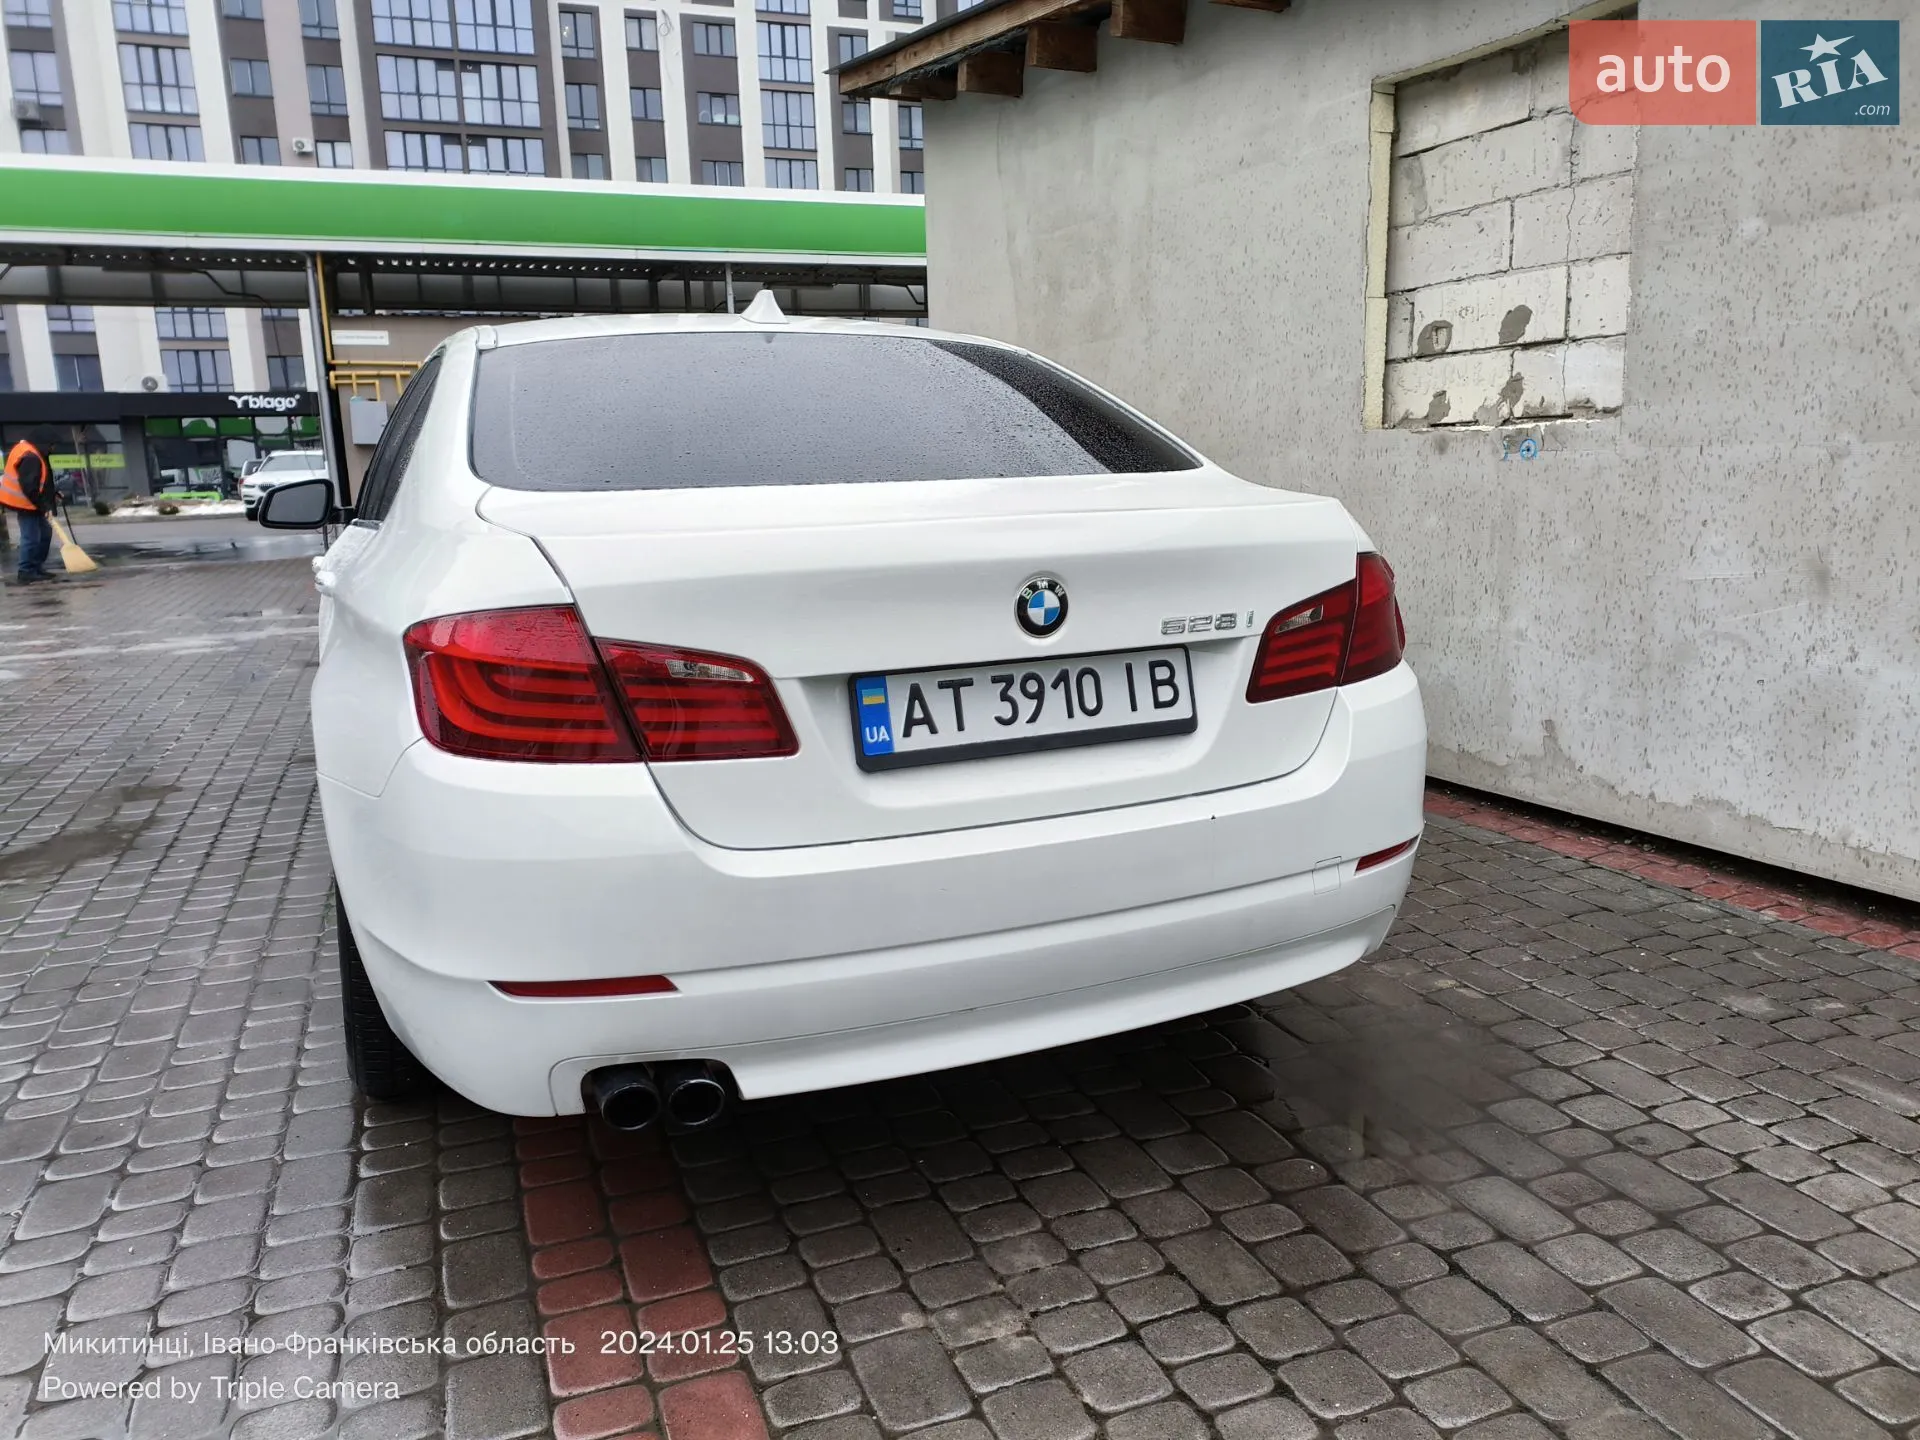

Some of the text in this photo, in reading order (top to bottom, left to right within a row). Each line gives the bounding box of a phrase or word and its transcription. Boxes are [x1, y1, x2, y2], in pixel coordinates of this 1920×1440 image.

[1020, 580, 1065, 600] BMW
[902, 659, 1180, 738] AT 3910 IB
[865, 725, 891, 744] UA
